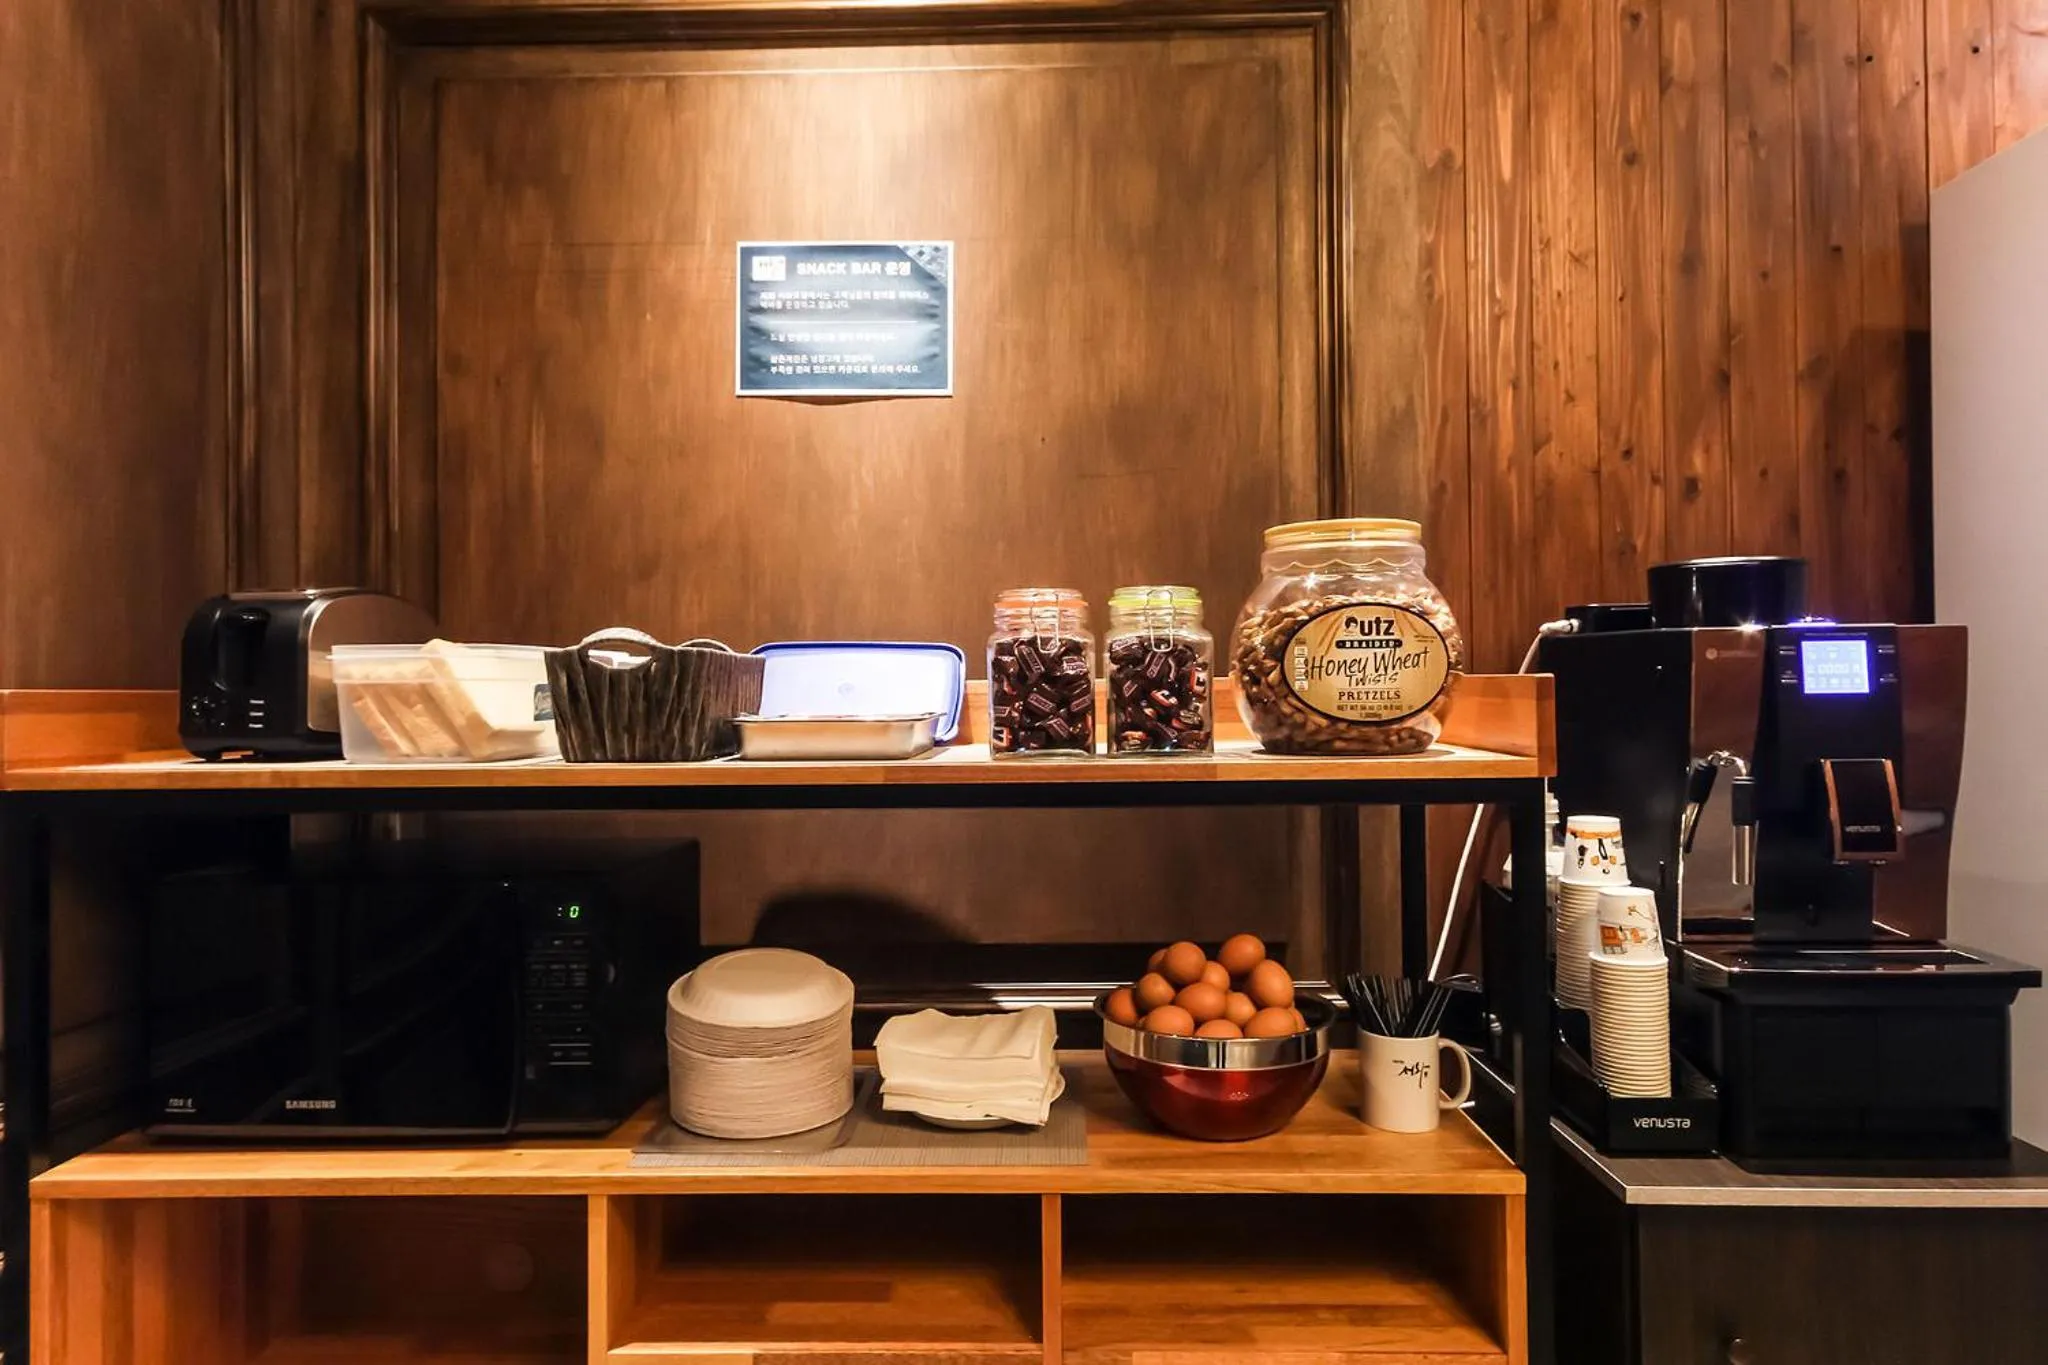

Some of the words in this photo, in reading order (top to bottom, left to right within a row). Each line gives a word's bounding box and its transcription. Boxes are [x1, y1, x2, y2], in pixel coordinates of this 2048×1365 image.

[796, 262, 846, 276] SNACK
[851, 262, 882, 276] BAR
[1311, 655, 1367, 681] Honey
[1373, 647, 1430, 674] Wheat
[1338, 690, 1401, 700] PRETZELS
[285, 1100, 337, 1109] SAMSUNG
